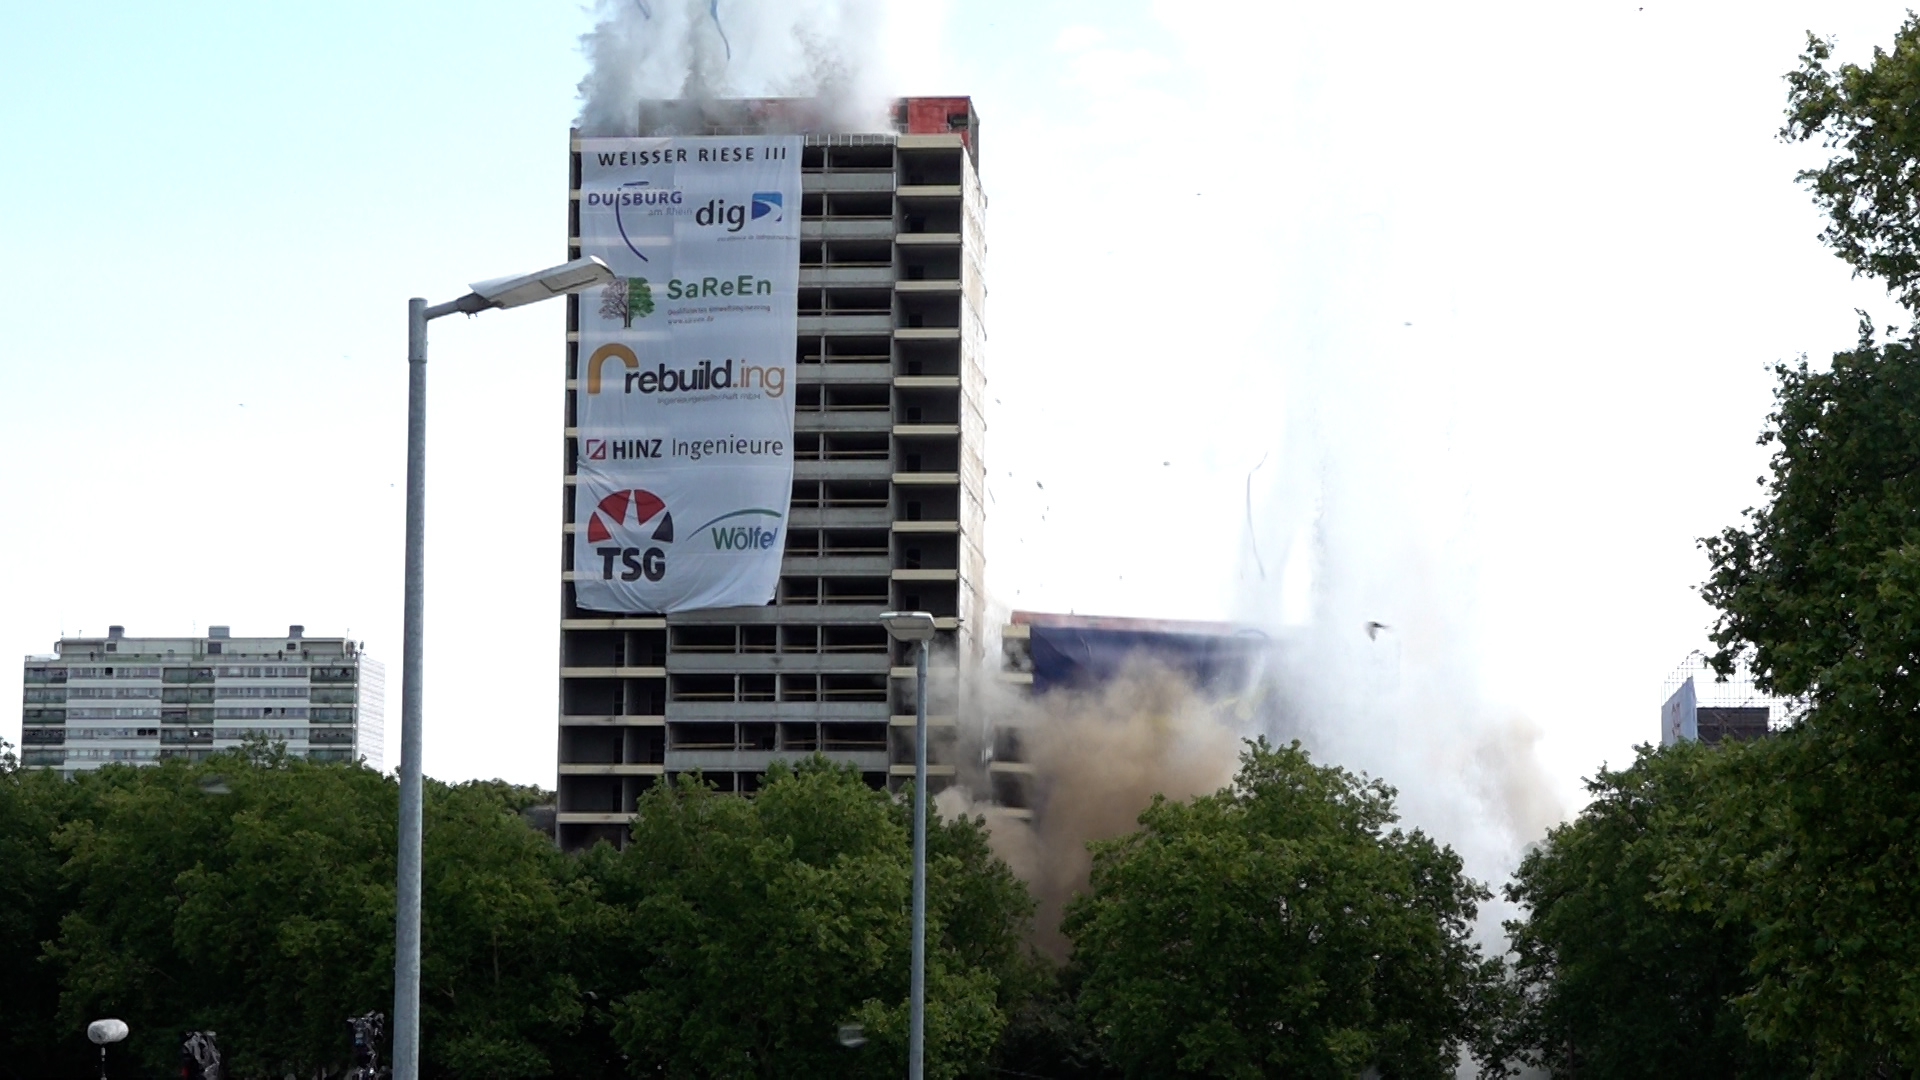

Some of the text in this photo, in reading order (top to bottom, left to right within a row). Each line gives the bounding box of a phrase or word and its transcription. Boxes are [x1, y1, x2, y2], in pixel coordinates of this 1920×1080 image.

[598, 148, 687, 166] WEISSER
[698, 147, 755, 163] RIESE
[695, 199, 745, 232] dig
[667, 275, 772, 300] SaReEn
[624, 358, 785, 398] rebuild.ing
[612, 434, 784, 461] HINZ Ingenieure
[597, 547, 666, 582] TSG
